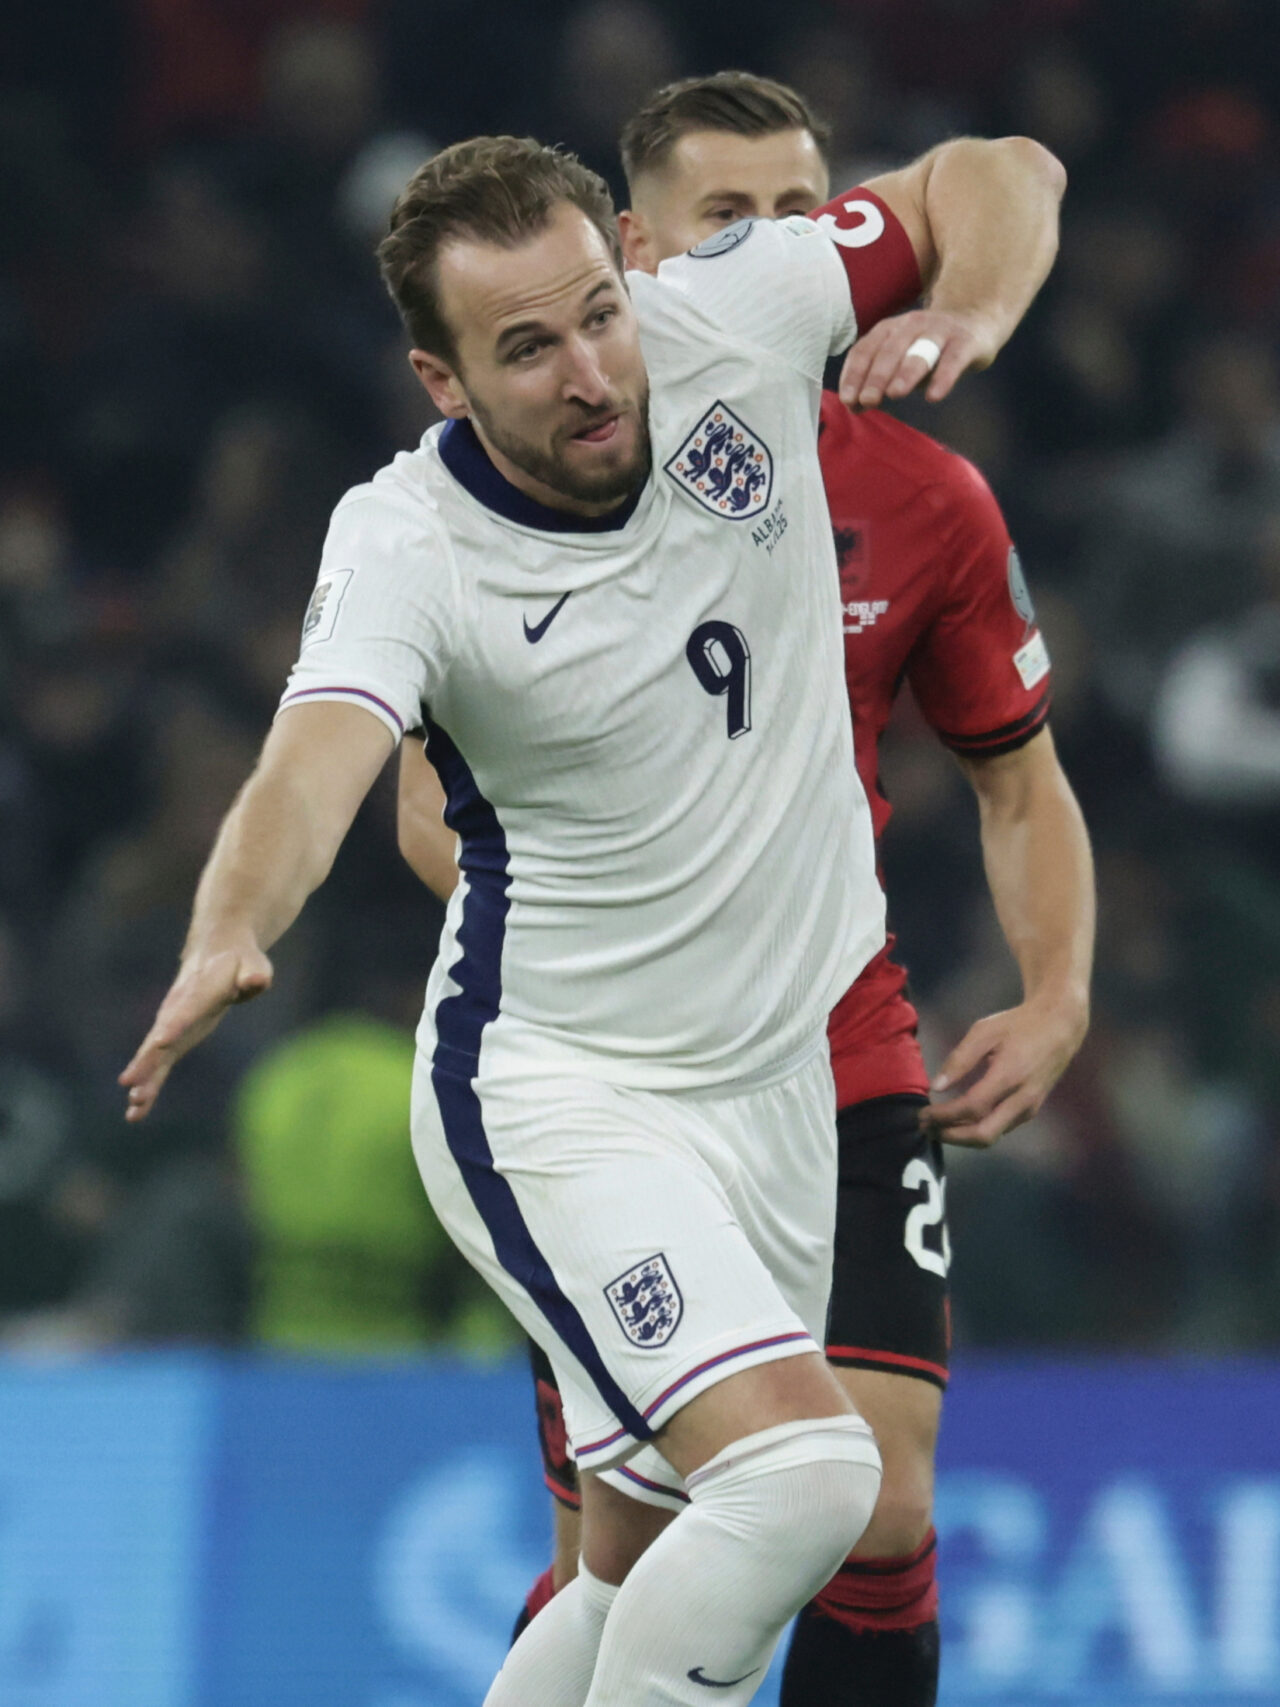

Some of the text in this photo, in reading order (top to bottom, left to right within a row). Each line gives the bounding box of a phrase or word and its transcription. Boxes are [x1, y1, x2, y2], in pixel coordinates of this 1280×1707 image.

[816, 200, 885, 248] C
[687, 620, 751, 740] 9
[902, 1158, 952, 1279] 2
